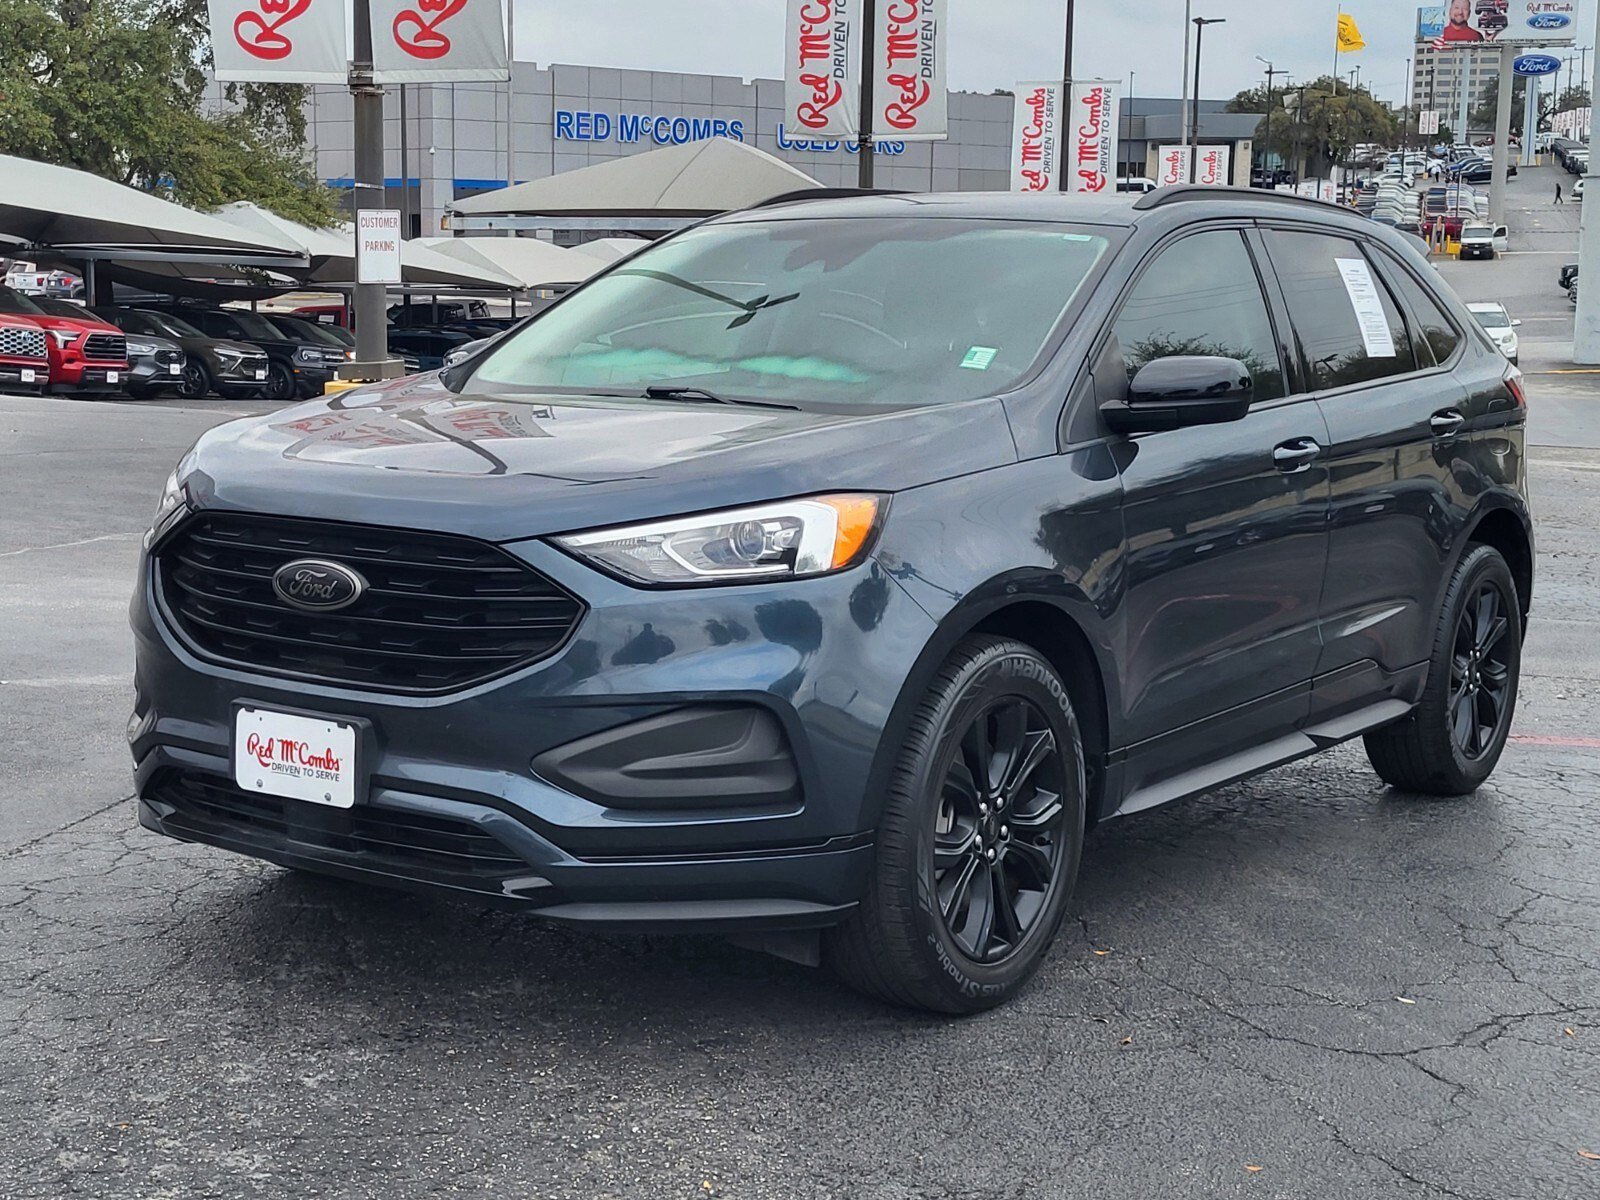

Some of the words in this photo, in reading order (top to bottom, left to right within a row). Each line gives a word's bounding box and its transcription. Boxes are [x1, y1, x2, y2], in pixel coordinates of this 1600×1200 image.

[1535, 16, 1562, 27] Ford
[833, 21, 846, 79] DRIVEN
[921, 20, 933, 79] DRIVEN
[1520, 58, 1551, 72] Ford
[797, 73, 842, 129] Red
[885, 73, 930, 129] Red
[1046, 87, 1056, 118] SERVE
[1102, 86, 1112, 117] SERVE
[555, 110, 612, 141] RED
[1021, 87, 1046, 167] McCombs
[1044, 121, 1053, 135] TO
[1077, 87, 1102, 167] McCombs
[1101, 120, 1110, 134] TO
[1043, 137, 1052, 174] DRIVEN
[1100, 136, 1108, 174] DRIVEN
[361, 216, 398, 229] CUSTOMER
[365, 240, 395, 252] PARKING
[288, 569, 338, 599] Ford
[246, 732, 275, 768] Red
[276, 738, 341, 772] McCombs
[271, 762, 301, 775] DRIVEN
[302, 767, 314, 778] TO
[315, 769, 341, 782] SERVE
